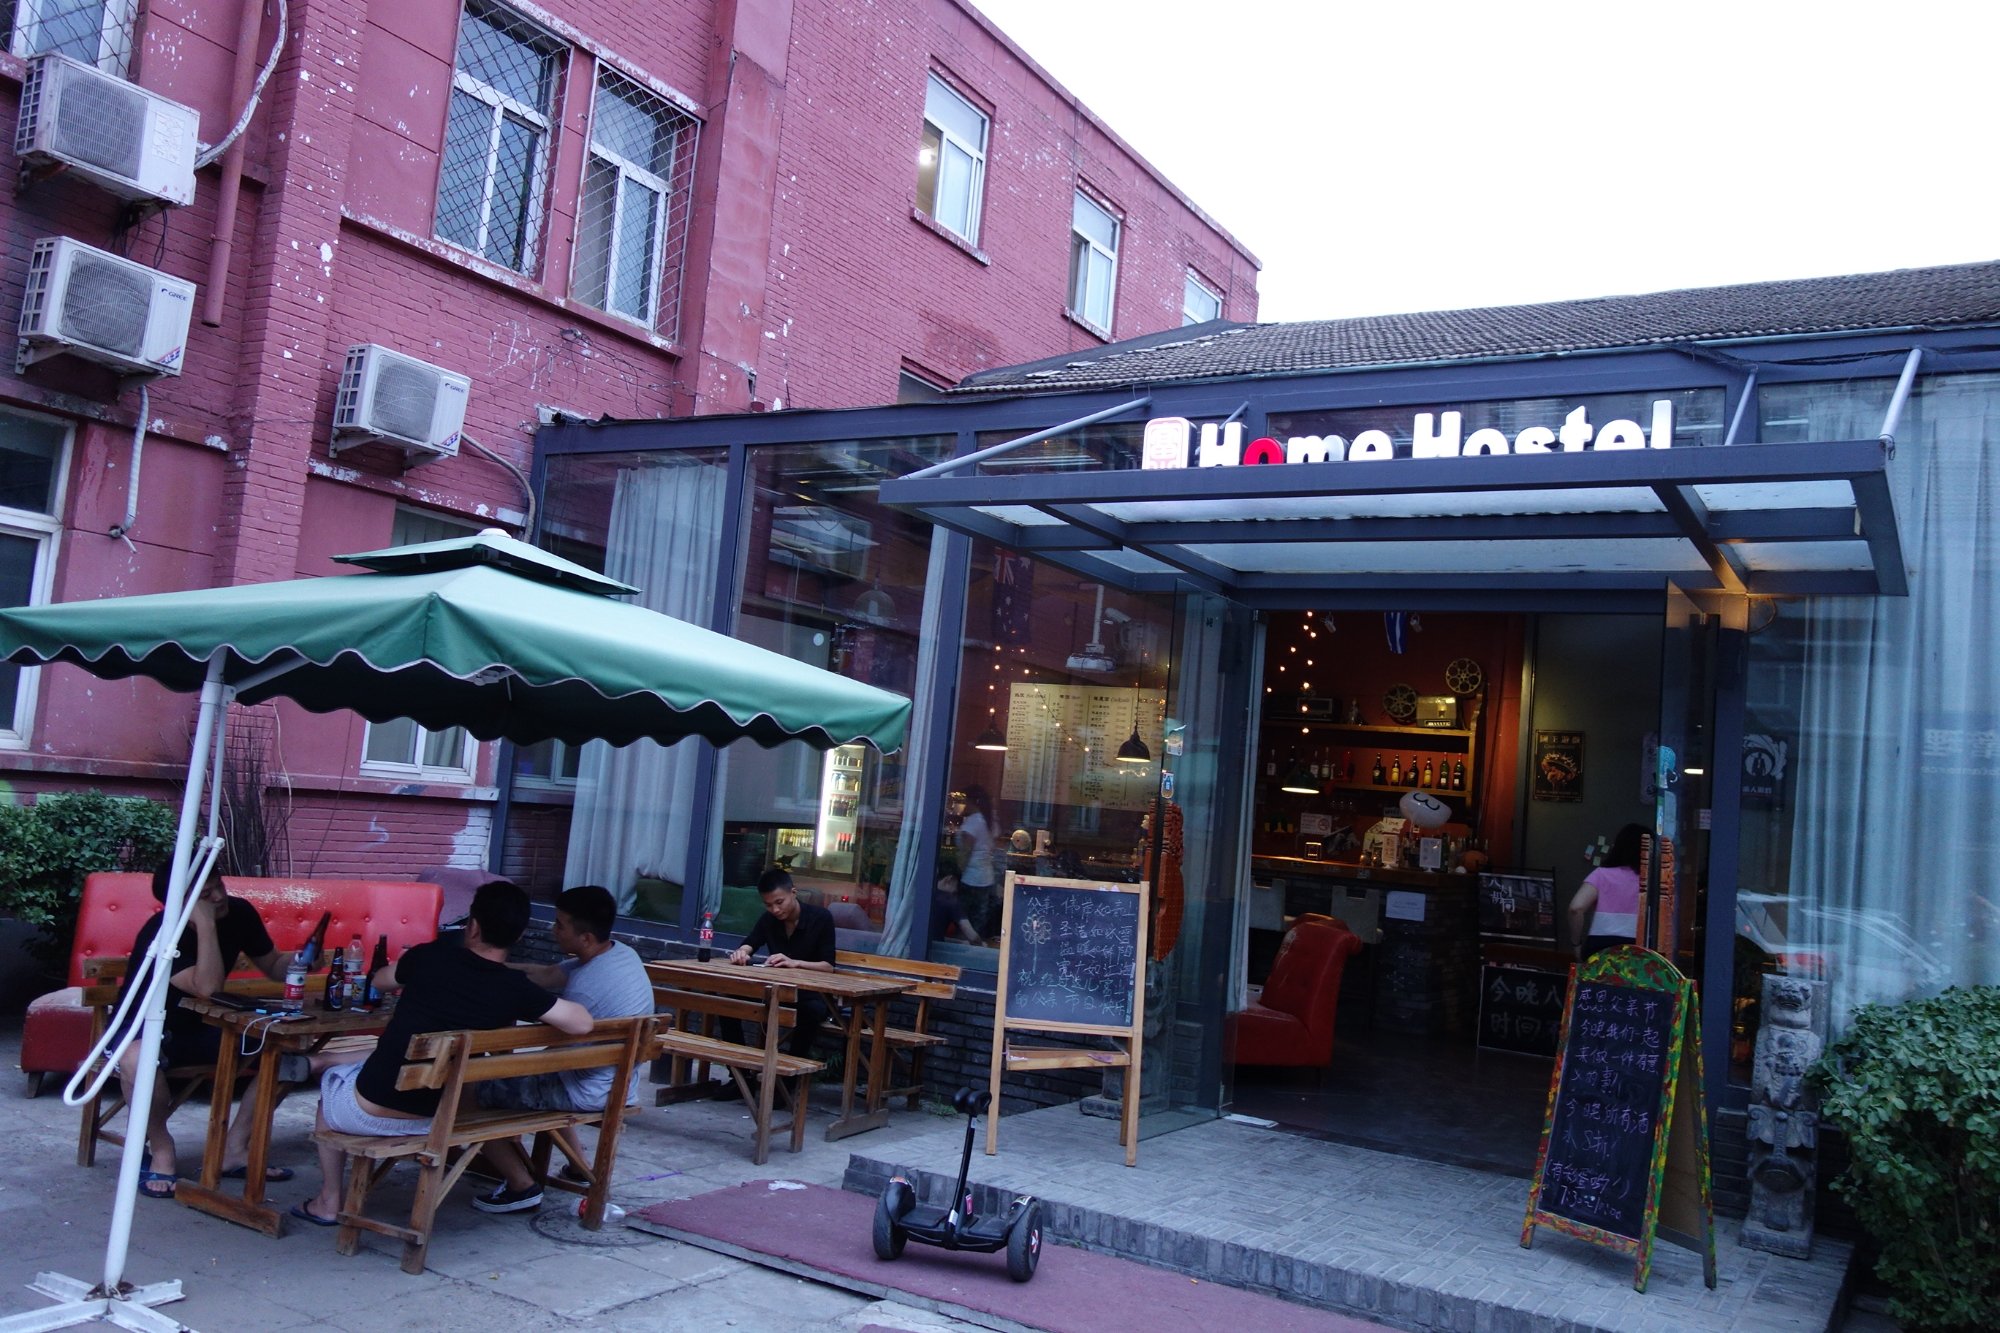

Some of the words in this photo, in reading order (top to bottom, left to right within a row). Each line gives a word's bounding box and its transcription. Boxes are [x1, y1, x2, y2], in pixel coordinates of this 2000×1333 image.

[1199, 420, 1394, 468] Home
[1412, 400, 1673, 458] Hostel
[1577, 988, 1658, 1024] 感恩父亲节
[1579, 1018, 1660, 1049] 今晚我们一起
[1564, 1097, 1650, 1136] 今晚所有酒
